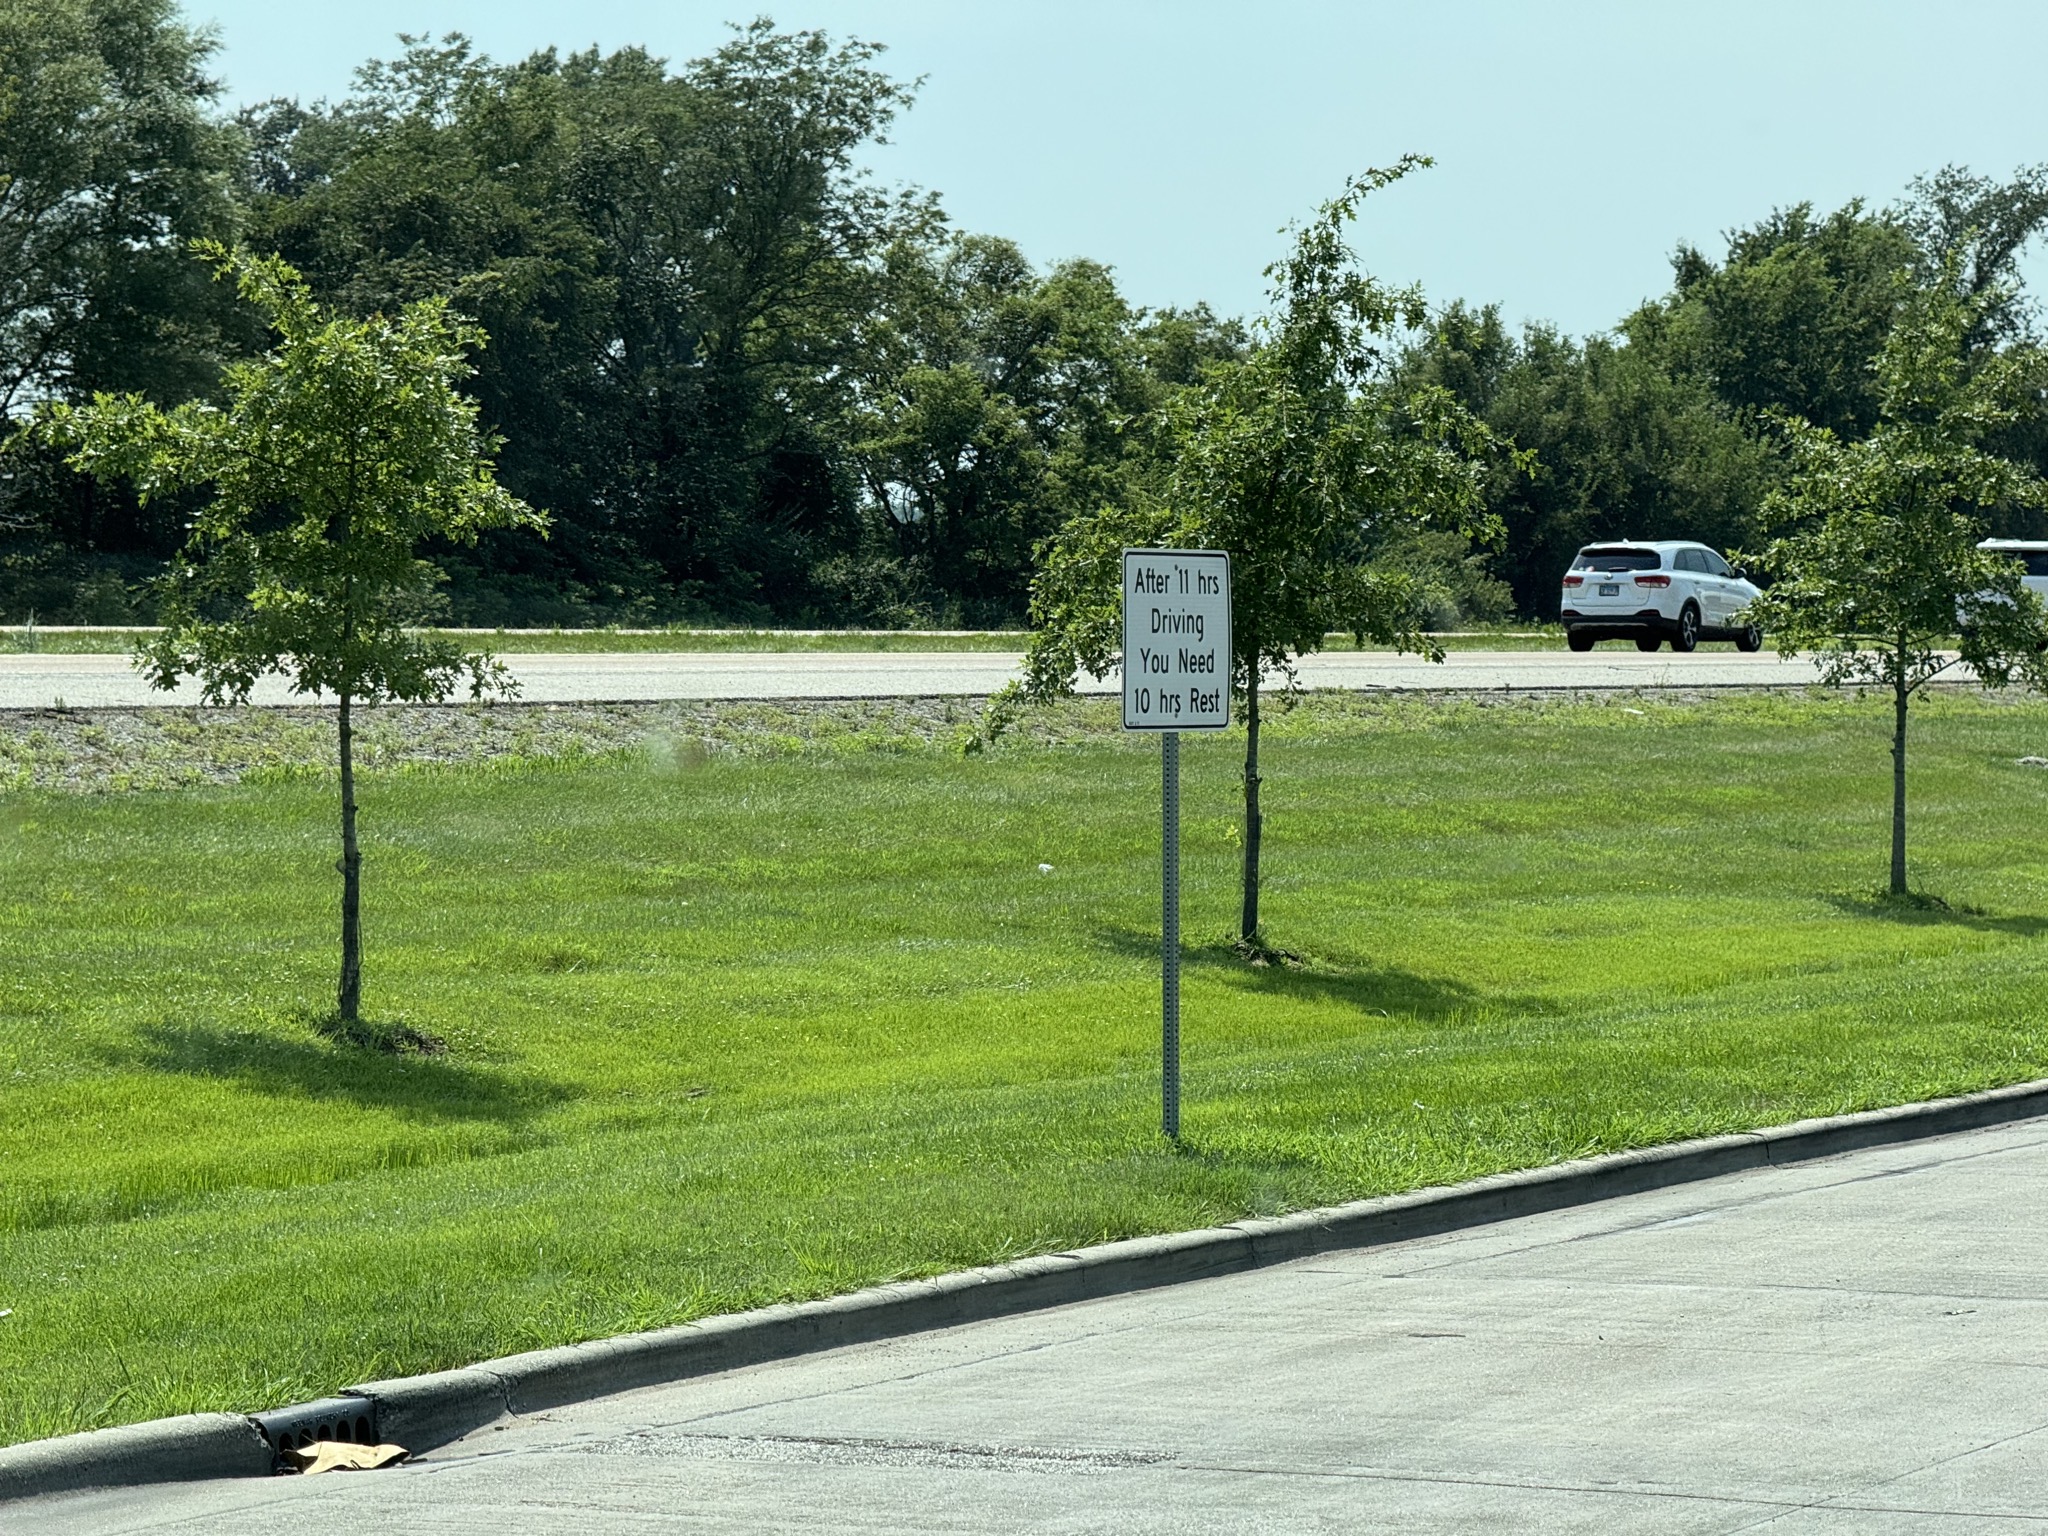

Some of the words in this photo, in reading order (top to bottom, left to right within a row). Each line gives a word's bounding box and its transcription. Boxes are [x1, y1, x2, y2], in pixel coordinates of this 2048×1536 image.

[1134, 567, 1170, 594] After
[1178, 568, 1189, 594] 11
[1197, 568, 1219, 595] hrs
[1151, 608, 1204, 643] Driving
[1140, 647, 1169, 674] You
[1178, 647, 1214, 674] Need
[1134, 687, 1151, 714] 10
[1159, 687, 1181, 714] hrs
[1190, 687, 1220, 714] Rest
